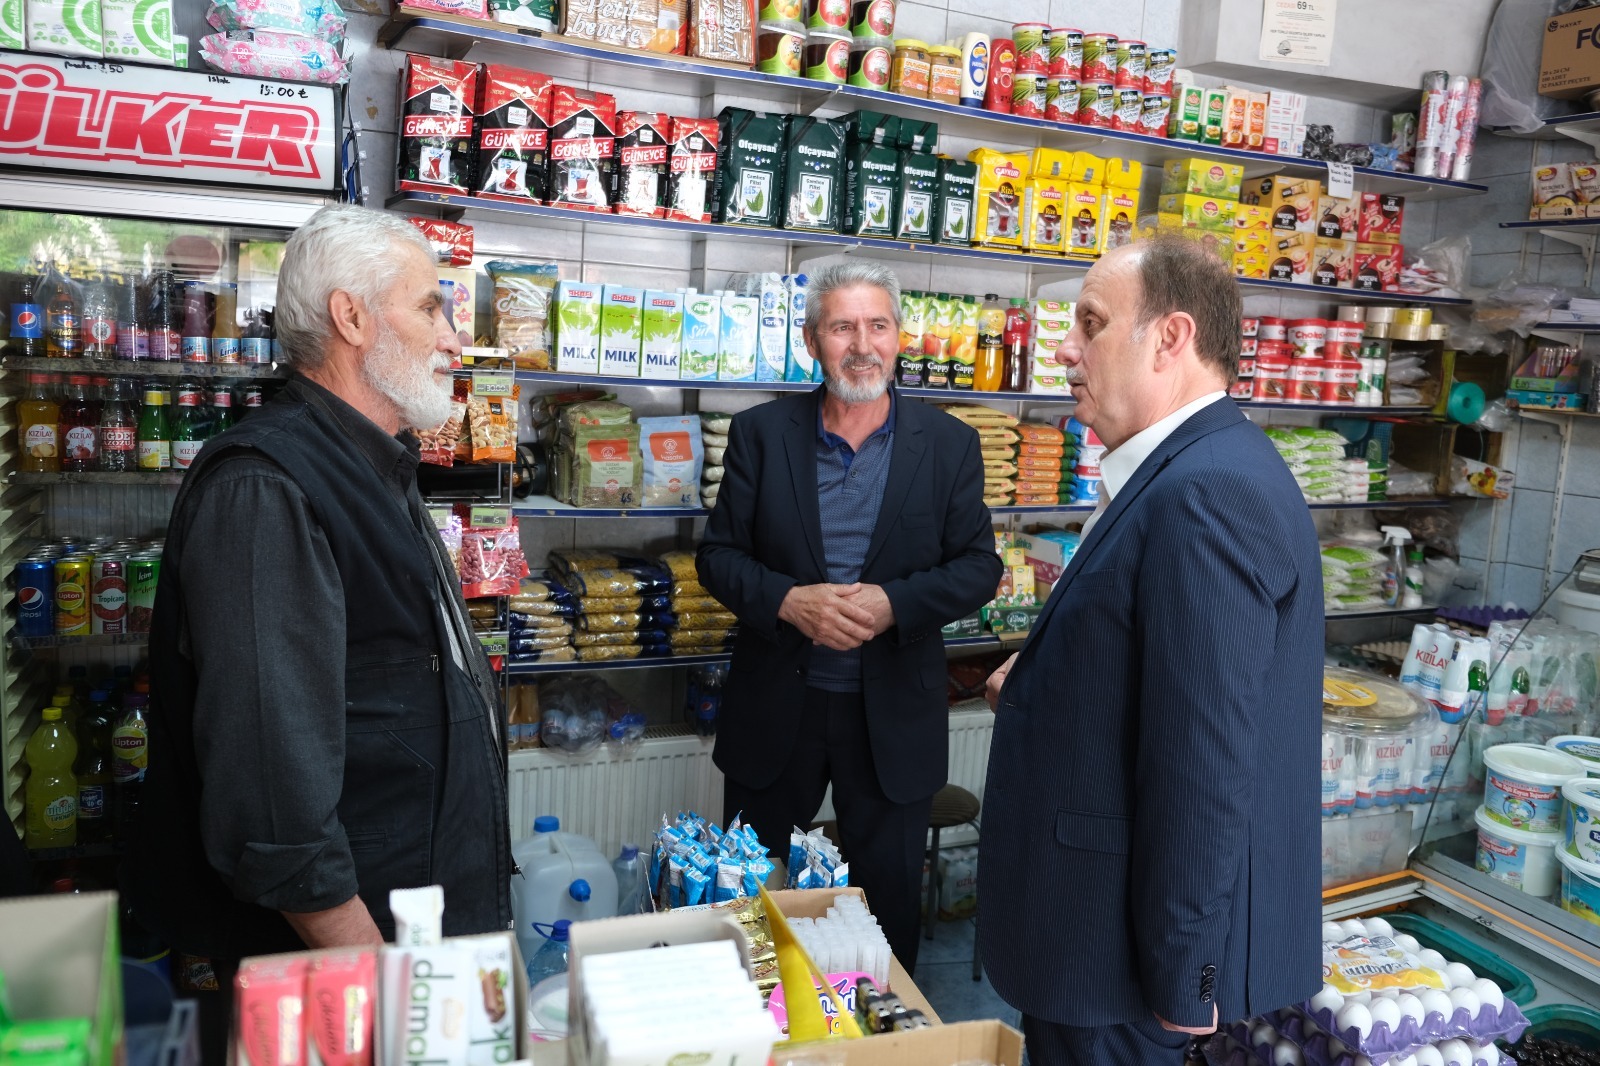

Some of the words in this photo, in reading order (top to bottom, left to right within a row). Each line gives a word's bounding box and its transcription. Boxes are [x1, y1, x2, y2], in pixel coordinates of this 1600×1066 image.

[1297, 1, 1307, 10] 69
[572, 13, 642, 44] beurre
[1560, 20, 1582, 29] HAYAT
[738, 139, 777, 153] Ofçaysan
[798, 144, 837, 158] Ofçaysan
[623, 148, 665, 163] GÜNEYCE
[862, 160, 896, 172] Ofçaysan
[904, 166, 936, 178] Ofçaysan
[944, 173, 974, 185] Ofçaysan
[1000, 185, 1014, 195] Rize
[562, 346, 596, 359] MILK
[604, 349, 637, 363] MILK
[646, 353, 677, 367] MILK
[901, 360, 924, 370] Cappy
[927, 362, 949, 372] Cappy
[953, 363, 974, 374] Cappy
[58, 592, 81, 600] Lipton
[97, 595, 125, 604] Tropicana
[20, 610, 42, 618] pepsi
[1416, 650, 1450, 670] KIZILAY
[114, 736, 143, 747] Lipton
